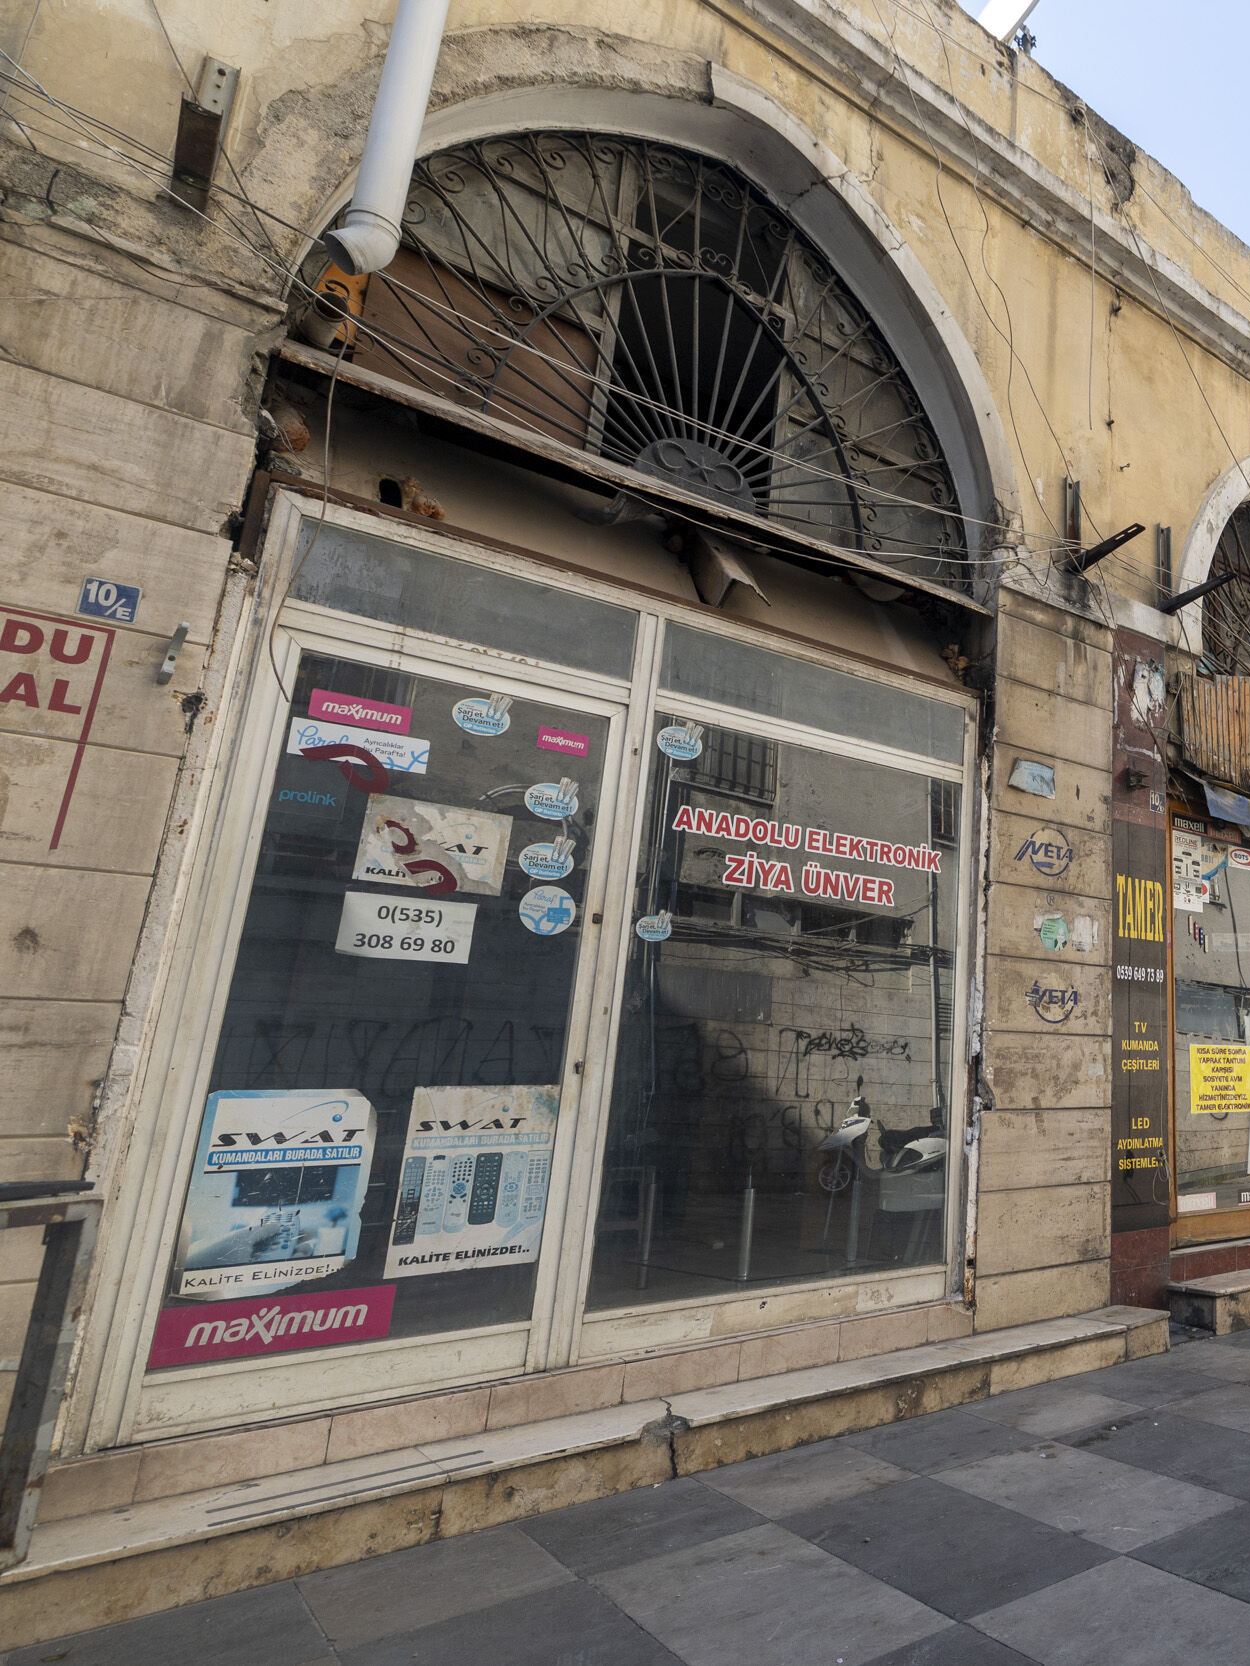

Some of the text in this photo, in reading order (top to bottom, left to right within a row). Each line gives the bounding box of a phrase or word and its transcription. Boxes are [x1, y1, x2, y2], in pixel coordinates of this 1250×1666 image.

[321, 701, 403, 725] maximum
[462, 714, 491, 727] Devam
[541, 734, 586, 750] maximum
[279, 788, 337, 808] prolink
[533, 800, 560, 811] Devam
[1174, 817, 1205, 833] maxell
[673, 806, 941, 873] ANADOLU ELEKTRONİK
[528, 860, 556, 871] Devam
[723, 852, 894, 906] ZİYA ÜNVER
[376, 904, 444, 928] 0(535)
[1117, 873, 1164, 943] TAMER
[353, 932, 456, 955] 308 69 80
[1116, 965, 1132, 980] 0539
[1134, 966, 1146, 982] 649
[1134, 1022, 1147, 1034] TV
[1121, 1040, 1159, 1051] KUMANDA
[1121, 1057, 1160, 1073] ÇEŞİTLERİ
[415, 1117, 527, 1132] SWAT
[1132, 1117, 1150, 1129] LED
[211, 1128, 366, 1149] SWAT
[1117, 1137, 1163, 1150] AYDINLATMA
[211, 1145, 360, 1165] KUMANDALARI BURADA SATILIR
[398, 1250, 452, 1267] KALİTE
[184, 1303, 369, 1348] maximum
